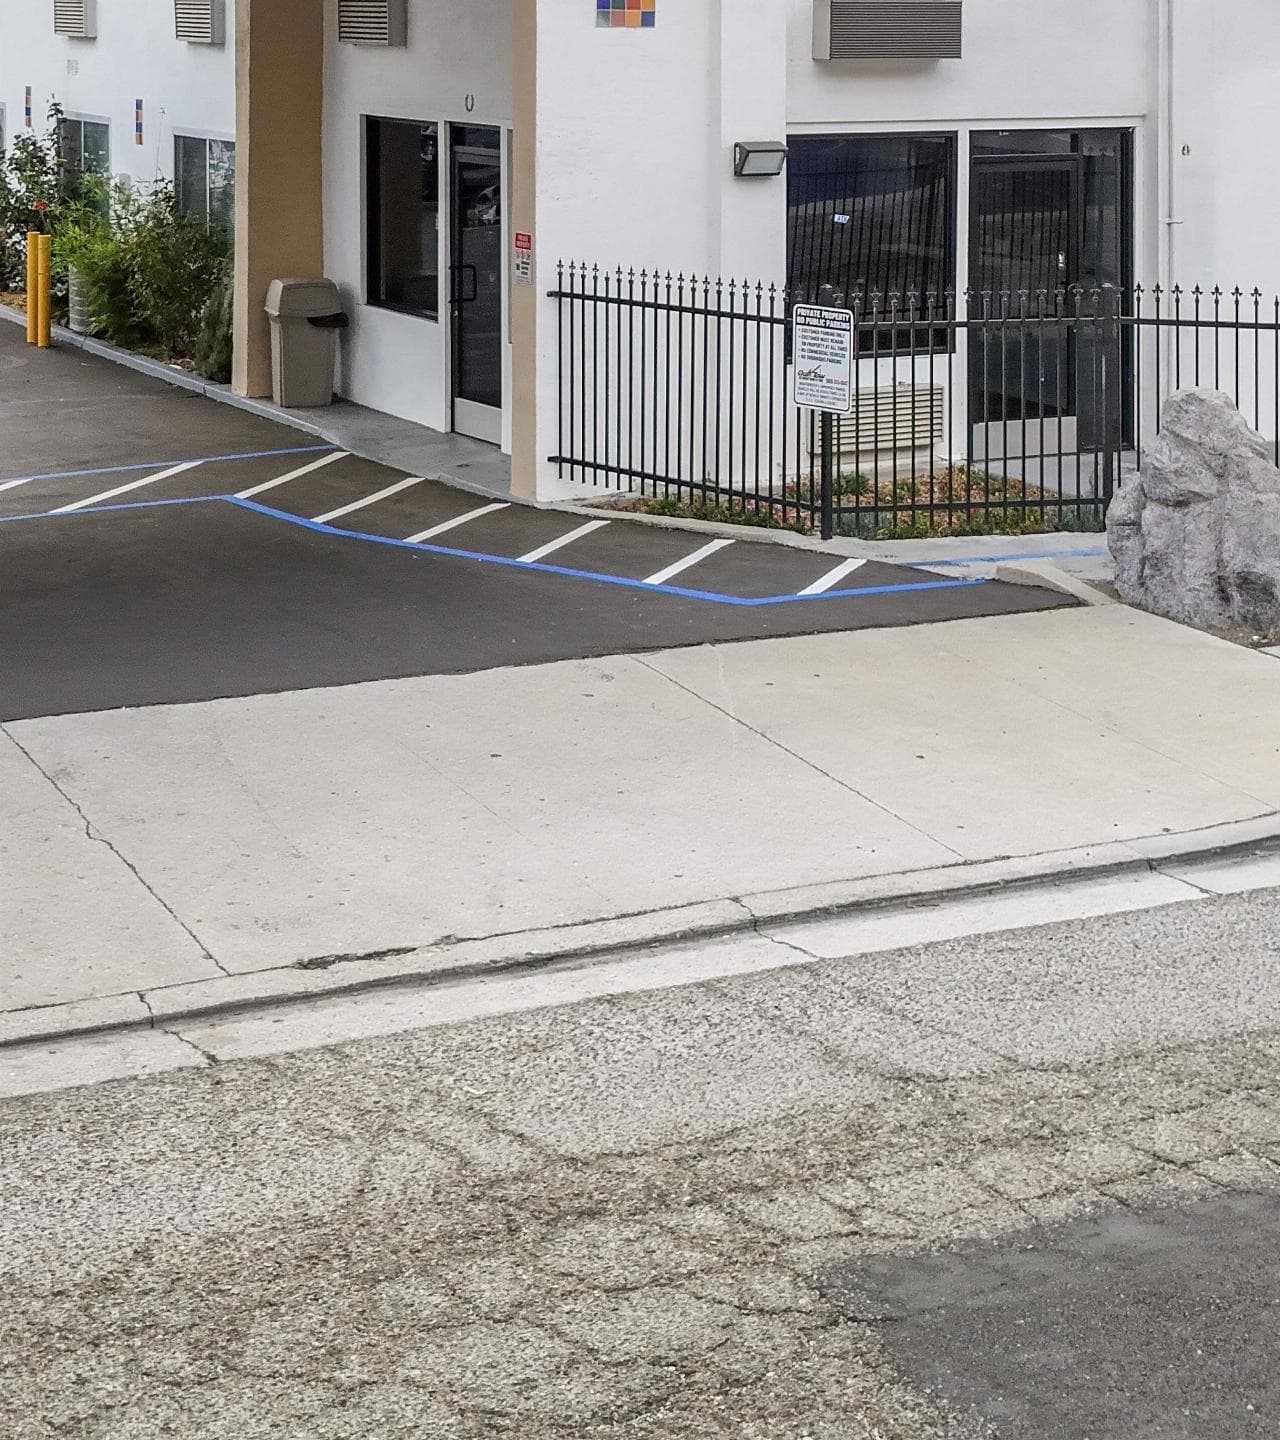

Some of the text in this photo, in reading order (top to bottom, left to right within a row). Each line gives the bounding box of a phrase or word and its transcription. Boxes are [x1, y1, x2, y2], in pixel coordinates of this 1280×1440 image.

[797, 308, 850, 321] PRIVATE PROPERTY
[796, 316, 850, 330] NO PUBLIC PARKING
